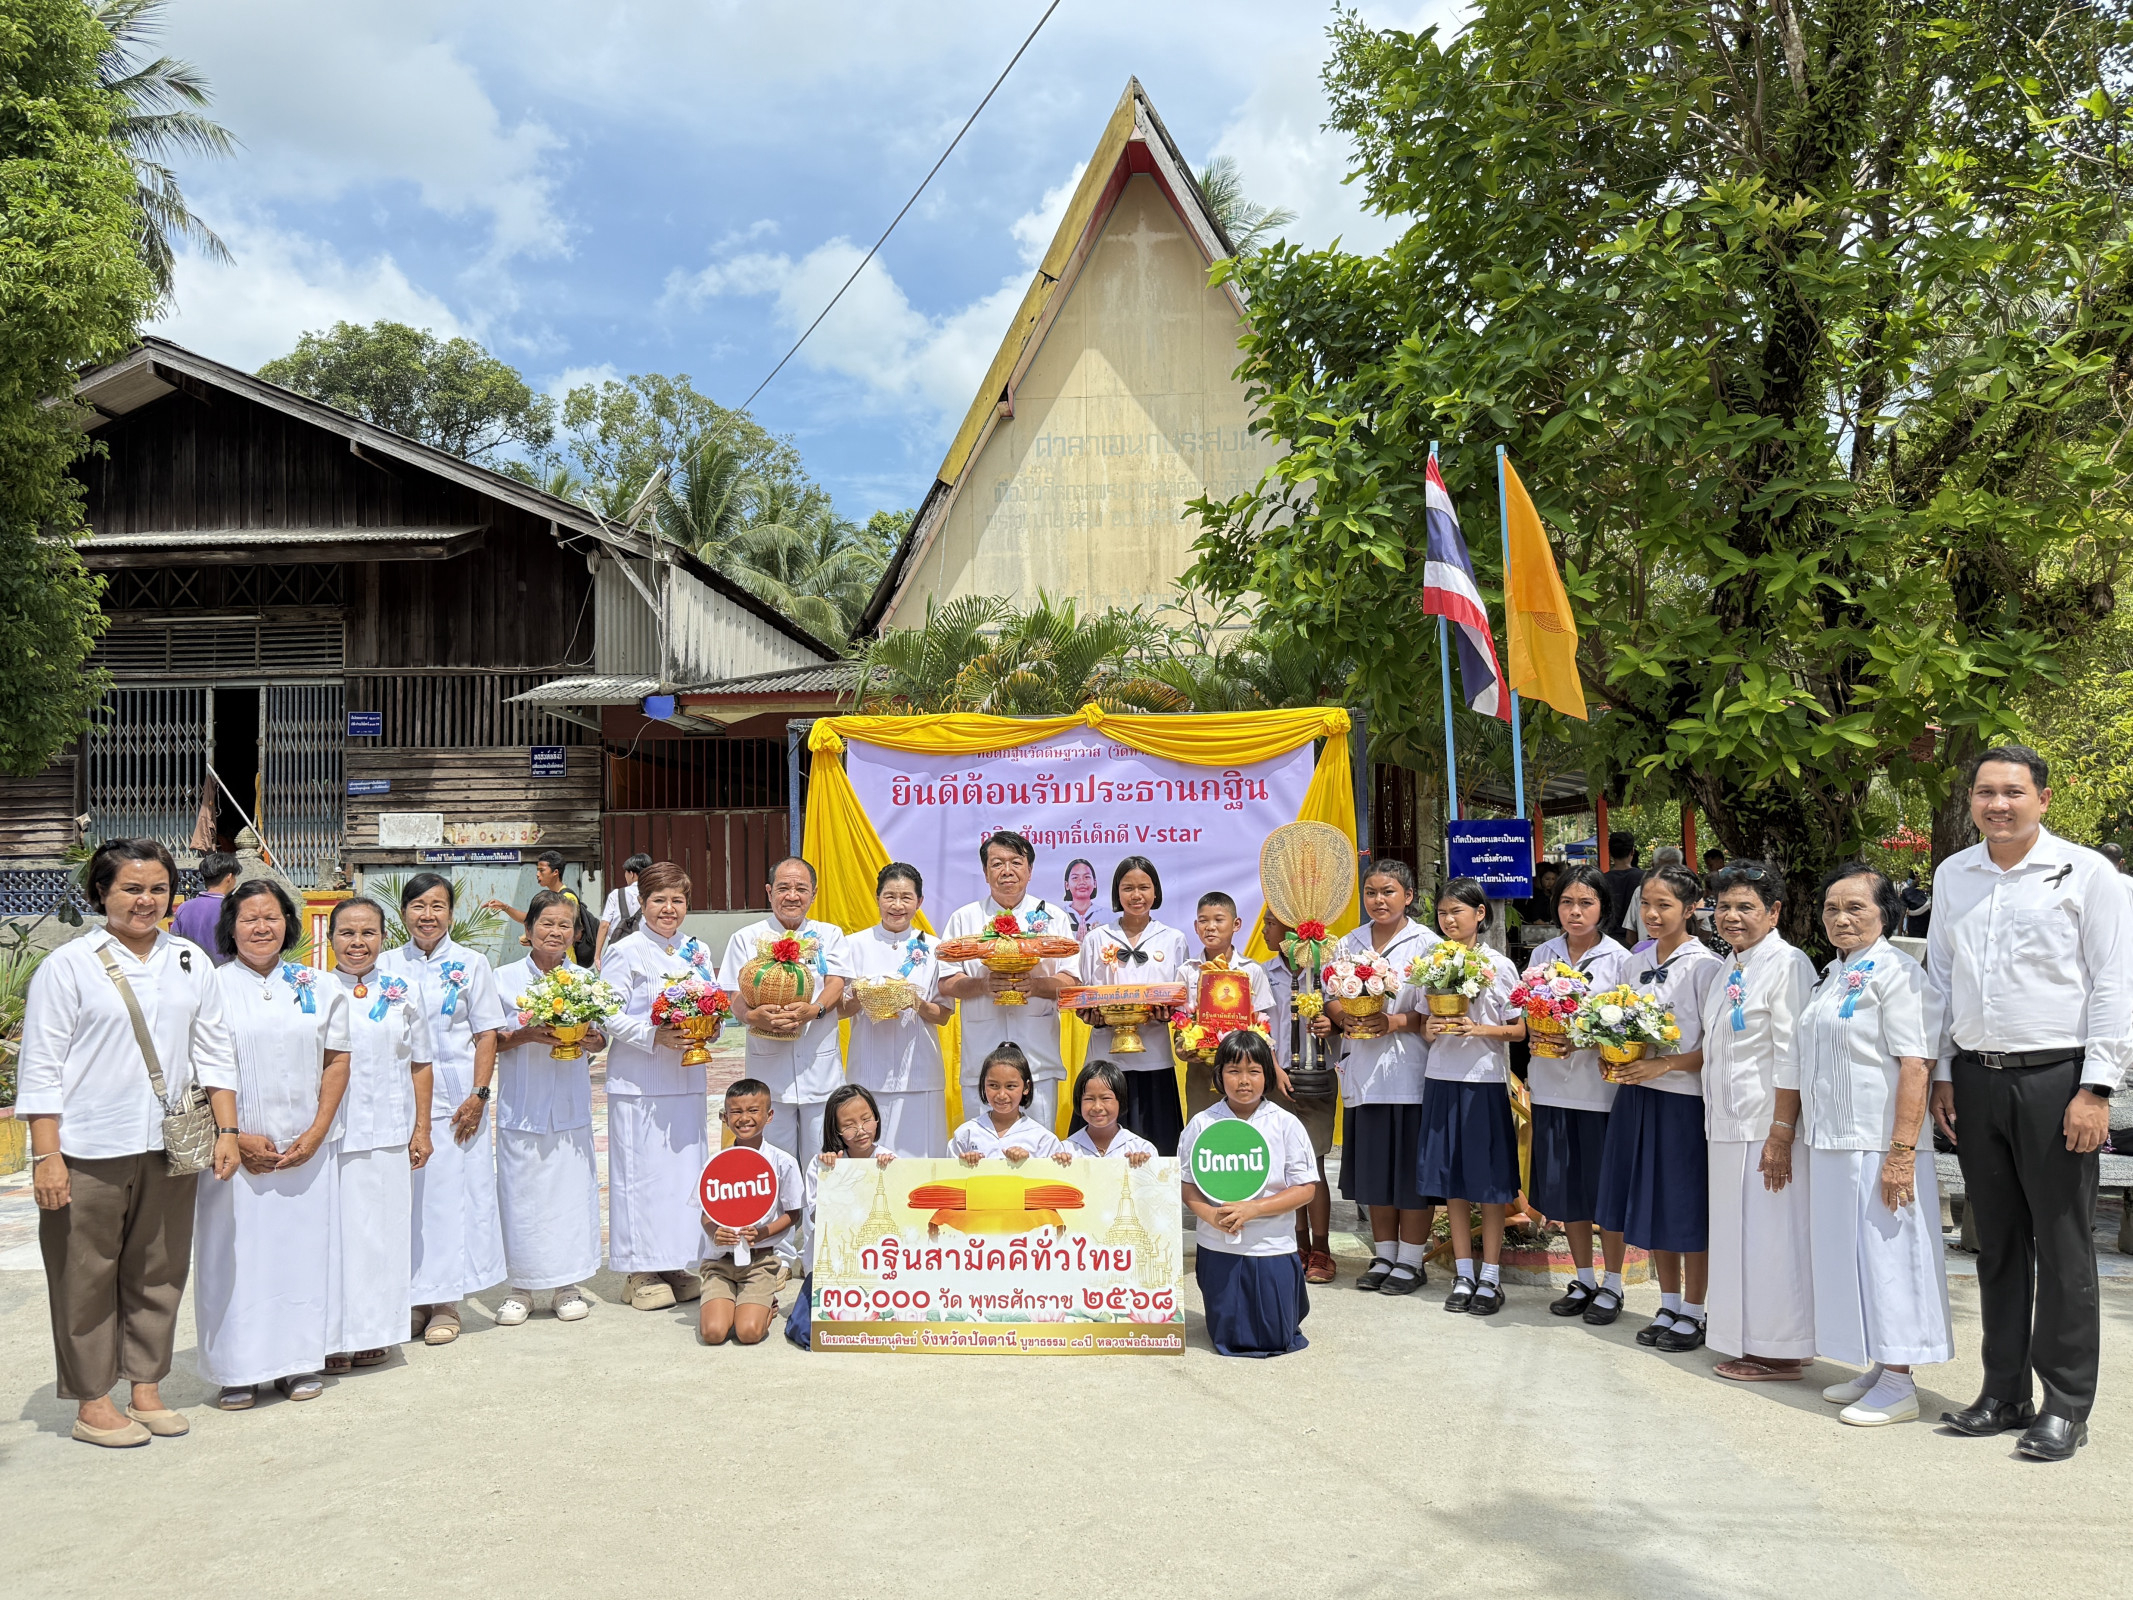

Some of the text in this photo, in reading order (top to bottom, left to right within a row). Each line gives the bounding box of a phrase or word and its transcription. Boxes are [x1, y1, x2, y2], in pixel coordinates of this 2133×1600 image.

[1035, 426, 1257, 458] ศาลาเอนกประสงค
[891, 770, 1269, 811] ยินดีต้อนรับประธานกฐิน
[980, 818, 1203, 850] กิสัมฤทธิ์เด็กดี V-star
[1198, 1145, 1264, 1173] ปัตตานี
[706, 1171, 772, 1202] ปัตตานี
[861, 1229, 1133, 1281] กฐินสามัคคีทั่วไทย
[823, 1286, 1174, 1316] ๓๐,๐๐๐ วัด พุทธศักราช ๒๕๖๘
[921, 1330, 1017, 1347] จังหวัดปัตตานี
